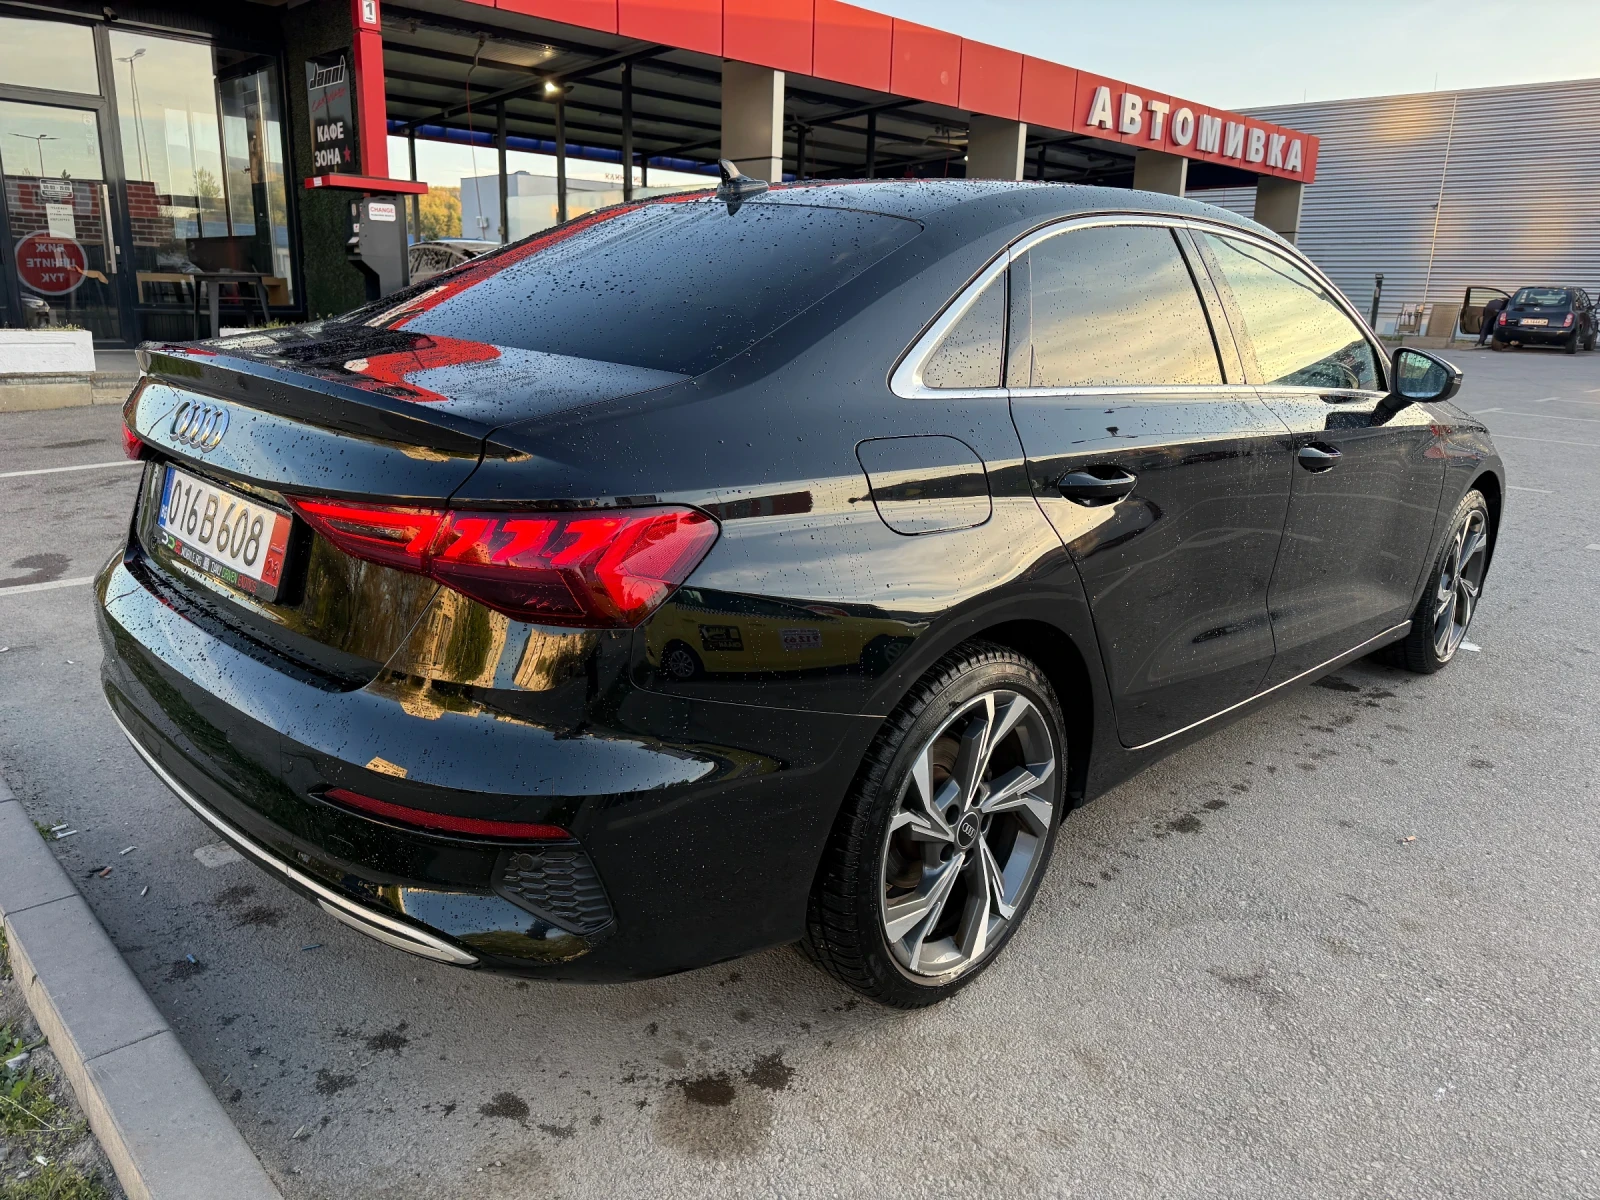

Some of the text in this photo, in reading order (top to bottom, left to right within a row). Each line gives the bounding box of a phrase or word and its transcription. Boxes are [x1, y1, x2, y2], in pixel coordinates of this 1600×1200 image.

[365, 2, 373, 15] 1
[316, 121, 344, 142] КАФЕ
[1086, 86, 1302, 172] АВТОМИВКА
[314, 147, 341, 167] ЗОНА
[370, 206, 394, 214] CHANGE
